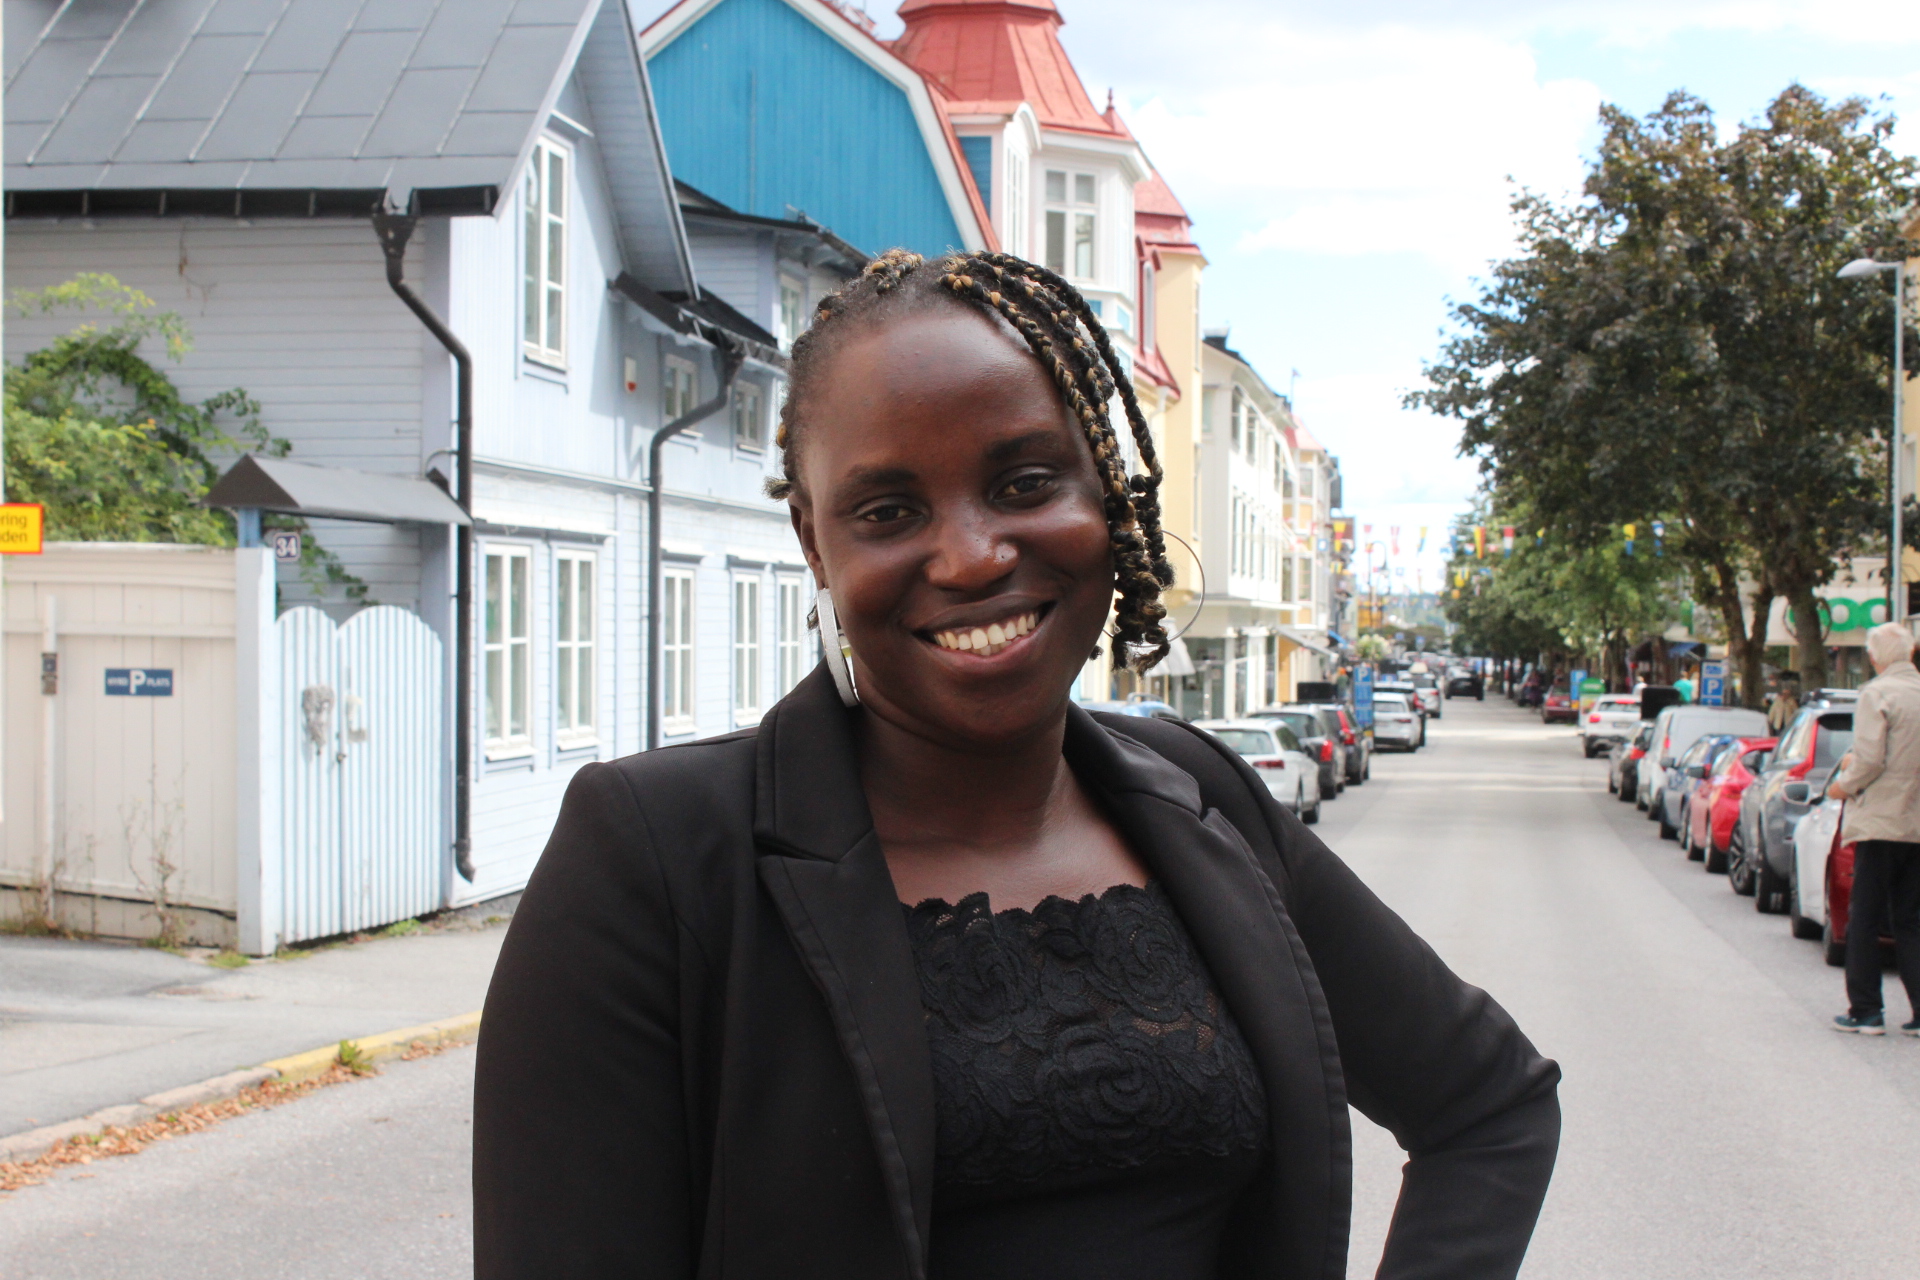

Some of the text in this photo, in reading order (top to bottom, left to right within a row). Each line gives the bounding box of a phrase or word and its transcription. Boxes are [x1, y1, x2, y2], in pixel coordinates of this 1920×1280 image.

[0, 530, 28, 543] den
[277, 537, 297, 557] 34
[130, 669, 146, 694] P
[1708, 680, 1719, 694] P
